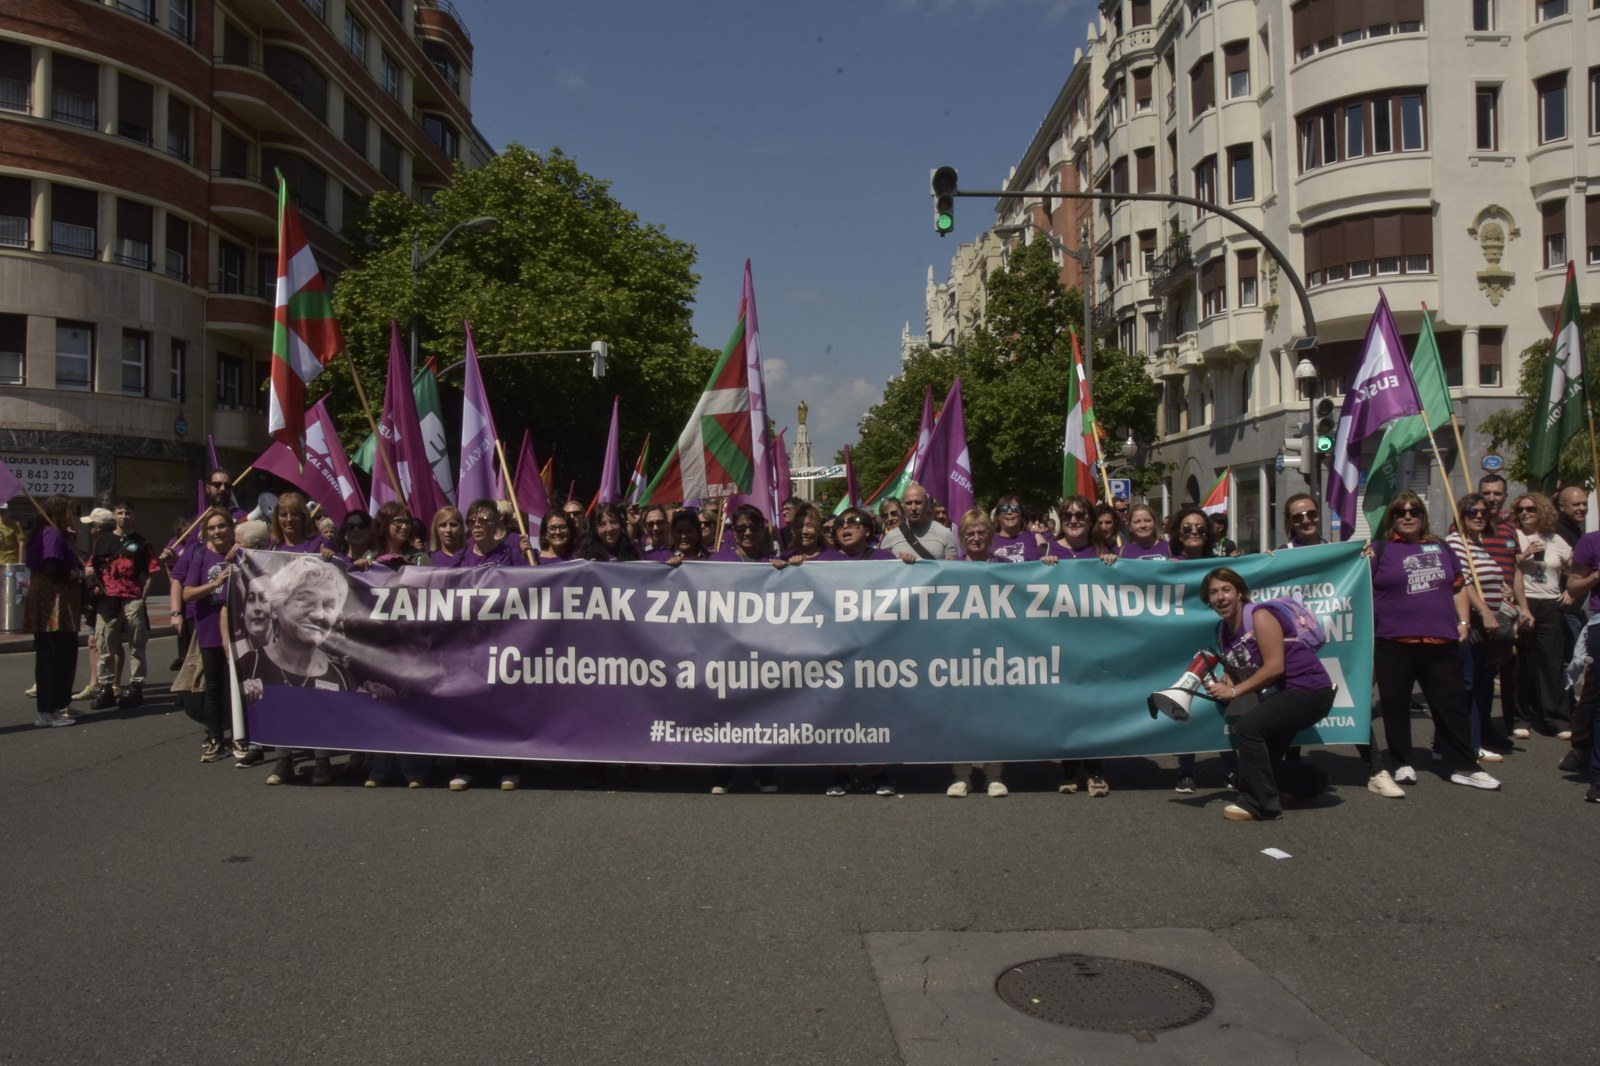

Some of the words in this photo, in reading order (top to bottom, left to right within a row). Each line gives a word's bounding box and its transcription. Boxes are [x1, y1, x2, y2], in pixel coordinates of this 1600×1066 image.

[40, 457, 59, 466] ESTE
[62, 458, 90, 467] LOCAL
[27, 470, 49, 480] 843
[53, 470, 75, 480] 320
[27, 482, 49, 492] 702
[53, 483, 75, 493] 722
[707, 481, 738, 497] ELA
[1110, 480, 1125, 498] P
[1410, 581, 1431, 592] ELA
[369, 586, 636, 622] ZAINTZAILEAK
[644, 589, 825, 629] ZAINDUZ,
[834, 584, 1017, 623] BIZITZAK
[1025, 583, 1186, 619] ZAINDU!
[487, 645, 668, 688] ¡Cuidemos
[675, 659, 696, 689] a
[705, 651, 845, 699] quienes
[854, 658, 919, 688] nos
[927, 645, 1061, 688] cuidan!
[650, 719, 891, 745] #ErresidentziakBorrokan
